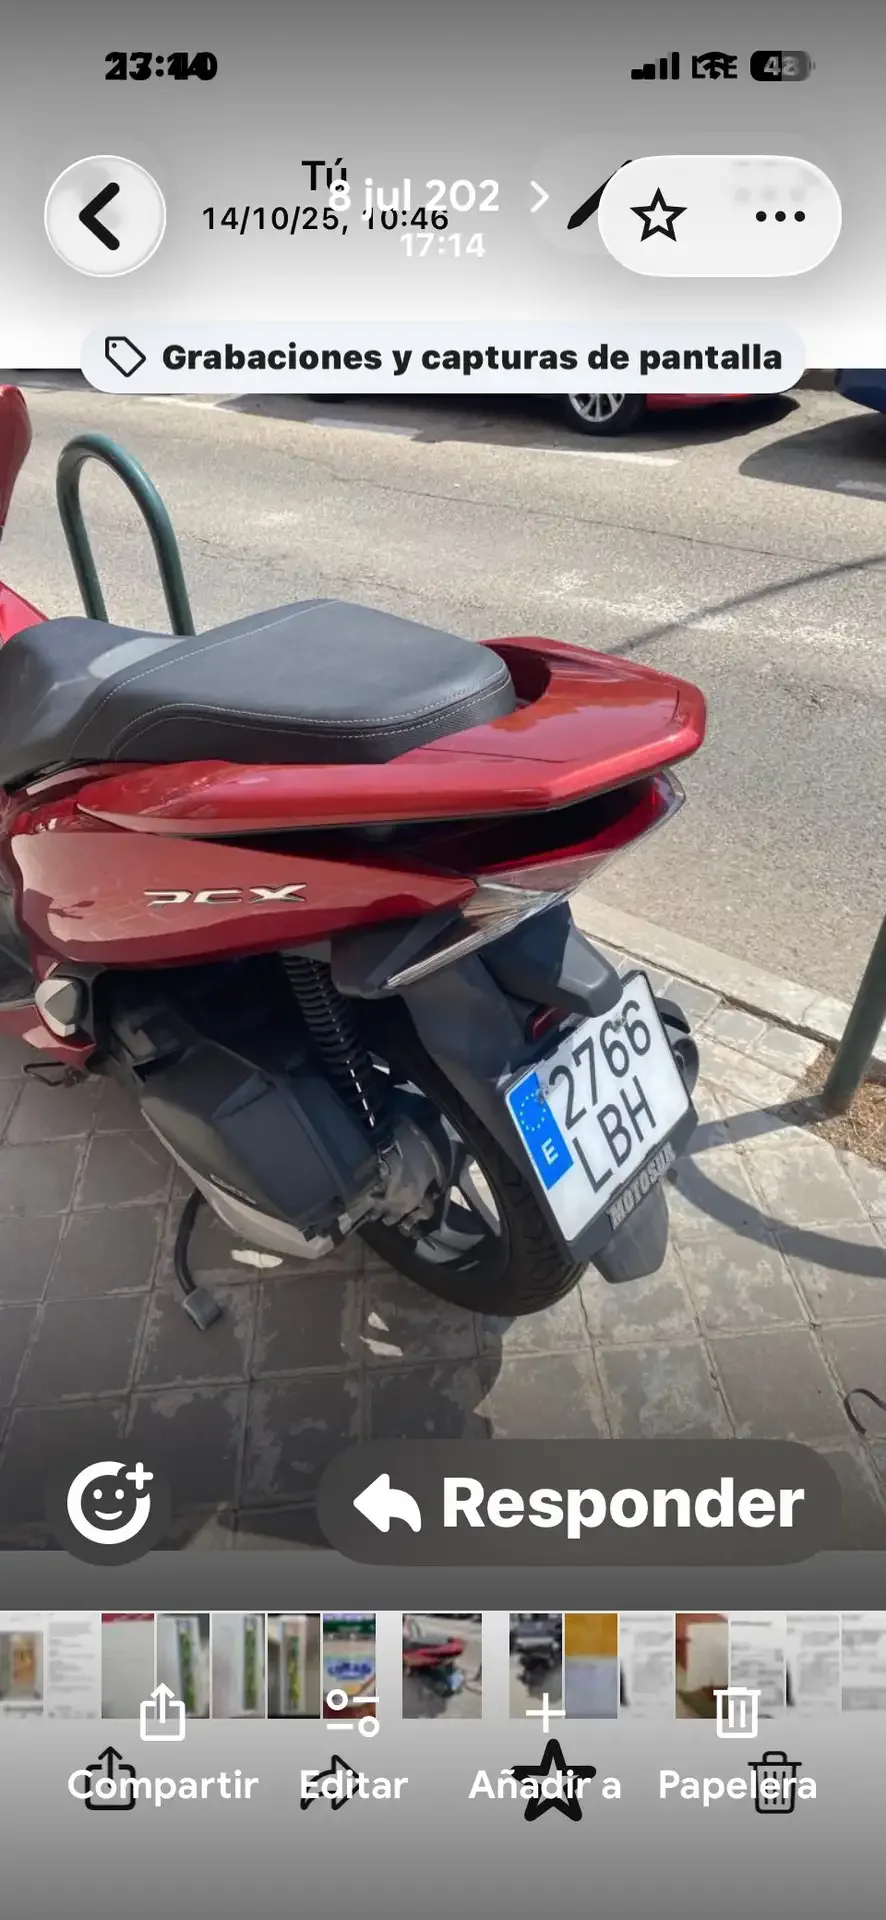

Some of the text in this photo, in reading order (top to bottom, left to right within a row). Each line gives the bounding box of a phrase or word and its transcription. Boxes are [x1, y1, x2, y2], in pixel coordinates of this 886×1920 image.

[143, 882, 308, 907] PCX
[549, 1000, 651, 1130] 2766
[540, 1138, 559, 1165] E
[572, 1075, 656, 1193] LBH
